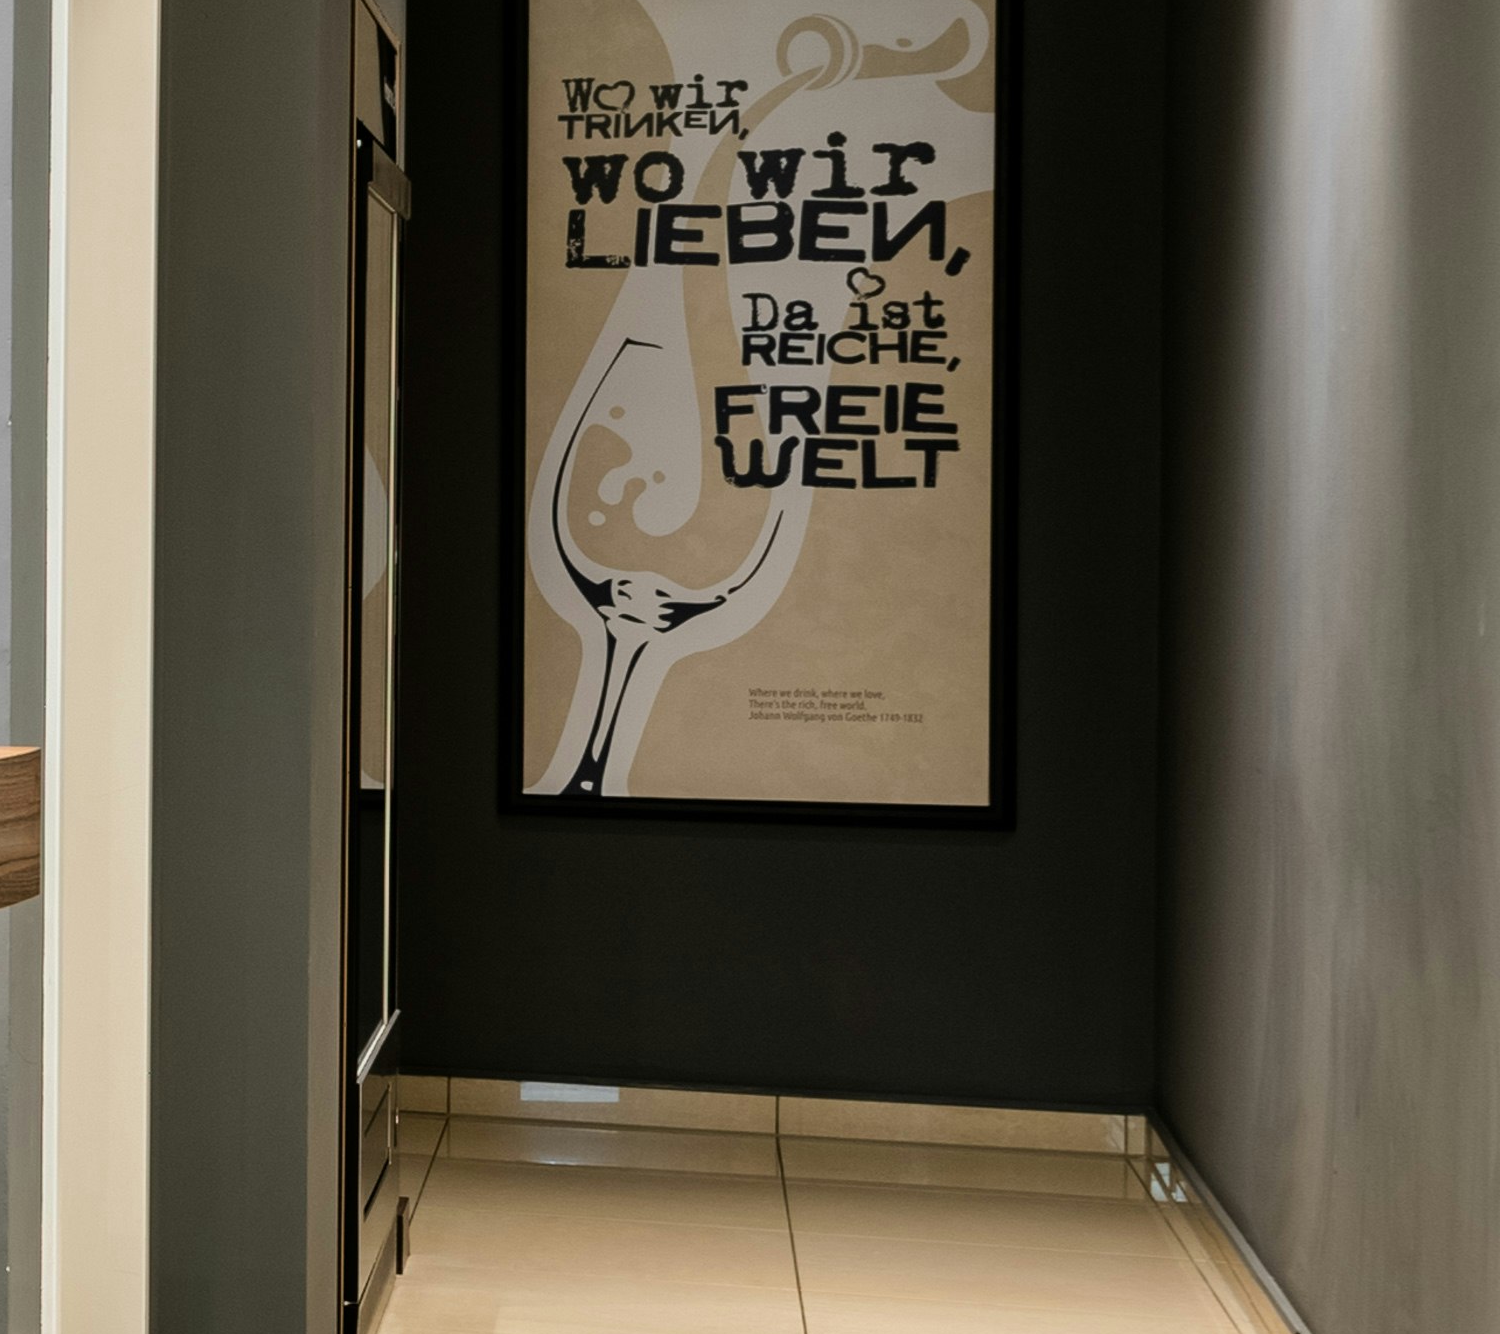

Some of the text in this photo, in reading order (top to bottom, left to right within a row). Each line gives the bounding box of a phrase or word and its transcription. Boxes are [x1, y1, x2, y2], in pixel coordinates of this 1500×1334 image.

[650, 74, 749, 110] wir
[558, 110, 749, 140] TRINKEN,
[737, 131, 936, 200] wir
[566, 200, 970, 276] LIEBEN,
[742, 267, 945, 332] Da ist
[742, 330, 960, 372] REICHE,
[715, 383, 957, 435] FREIE
[715, 436, 960, 489] WELT
[749, 689, 777, 697] Where
[794, 689, 819, 699] drink,
[821, 690, 847, 698] where
[865, 690, 885, 700] love,
[749, 699, 867, 710] There's the rich, free world.
[749, 711, 780, 720] Johann
[783, 712, 825, 722] Wolfgang
[845, 713, 877, 722] Goethe
